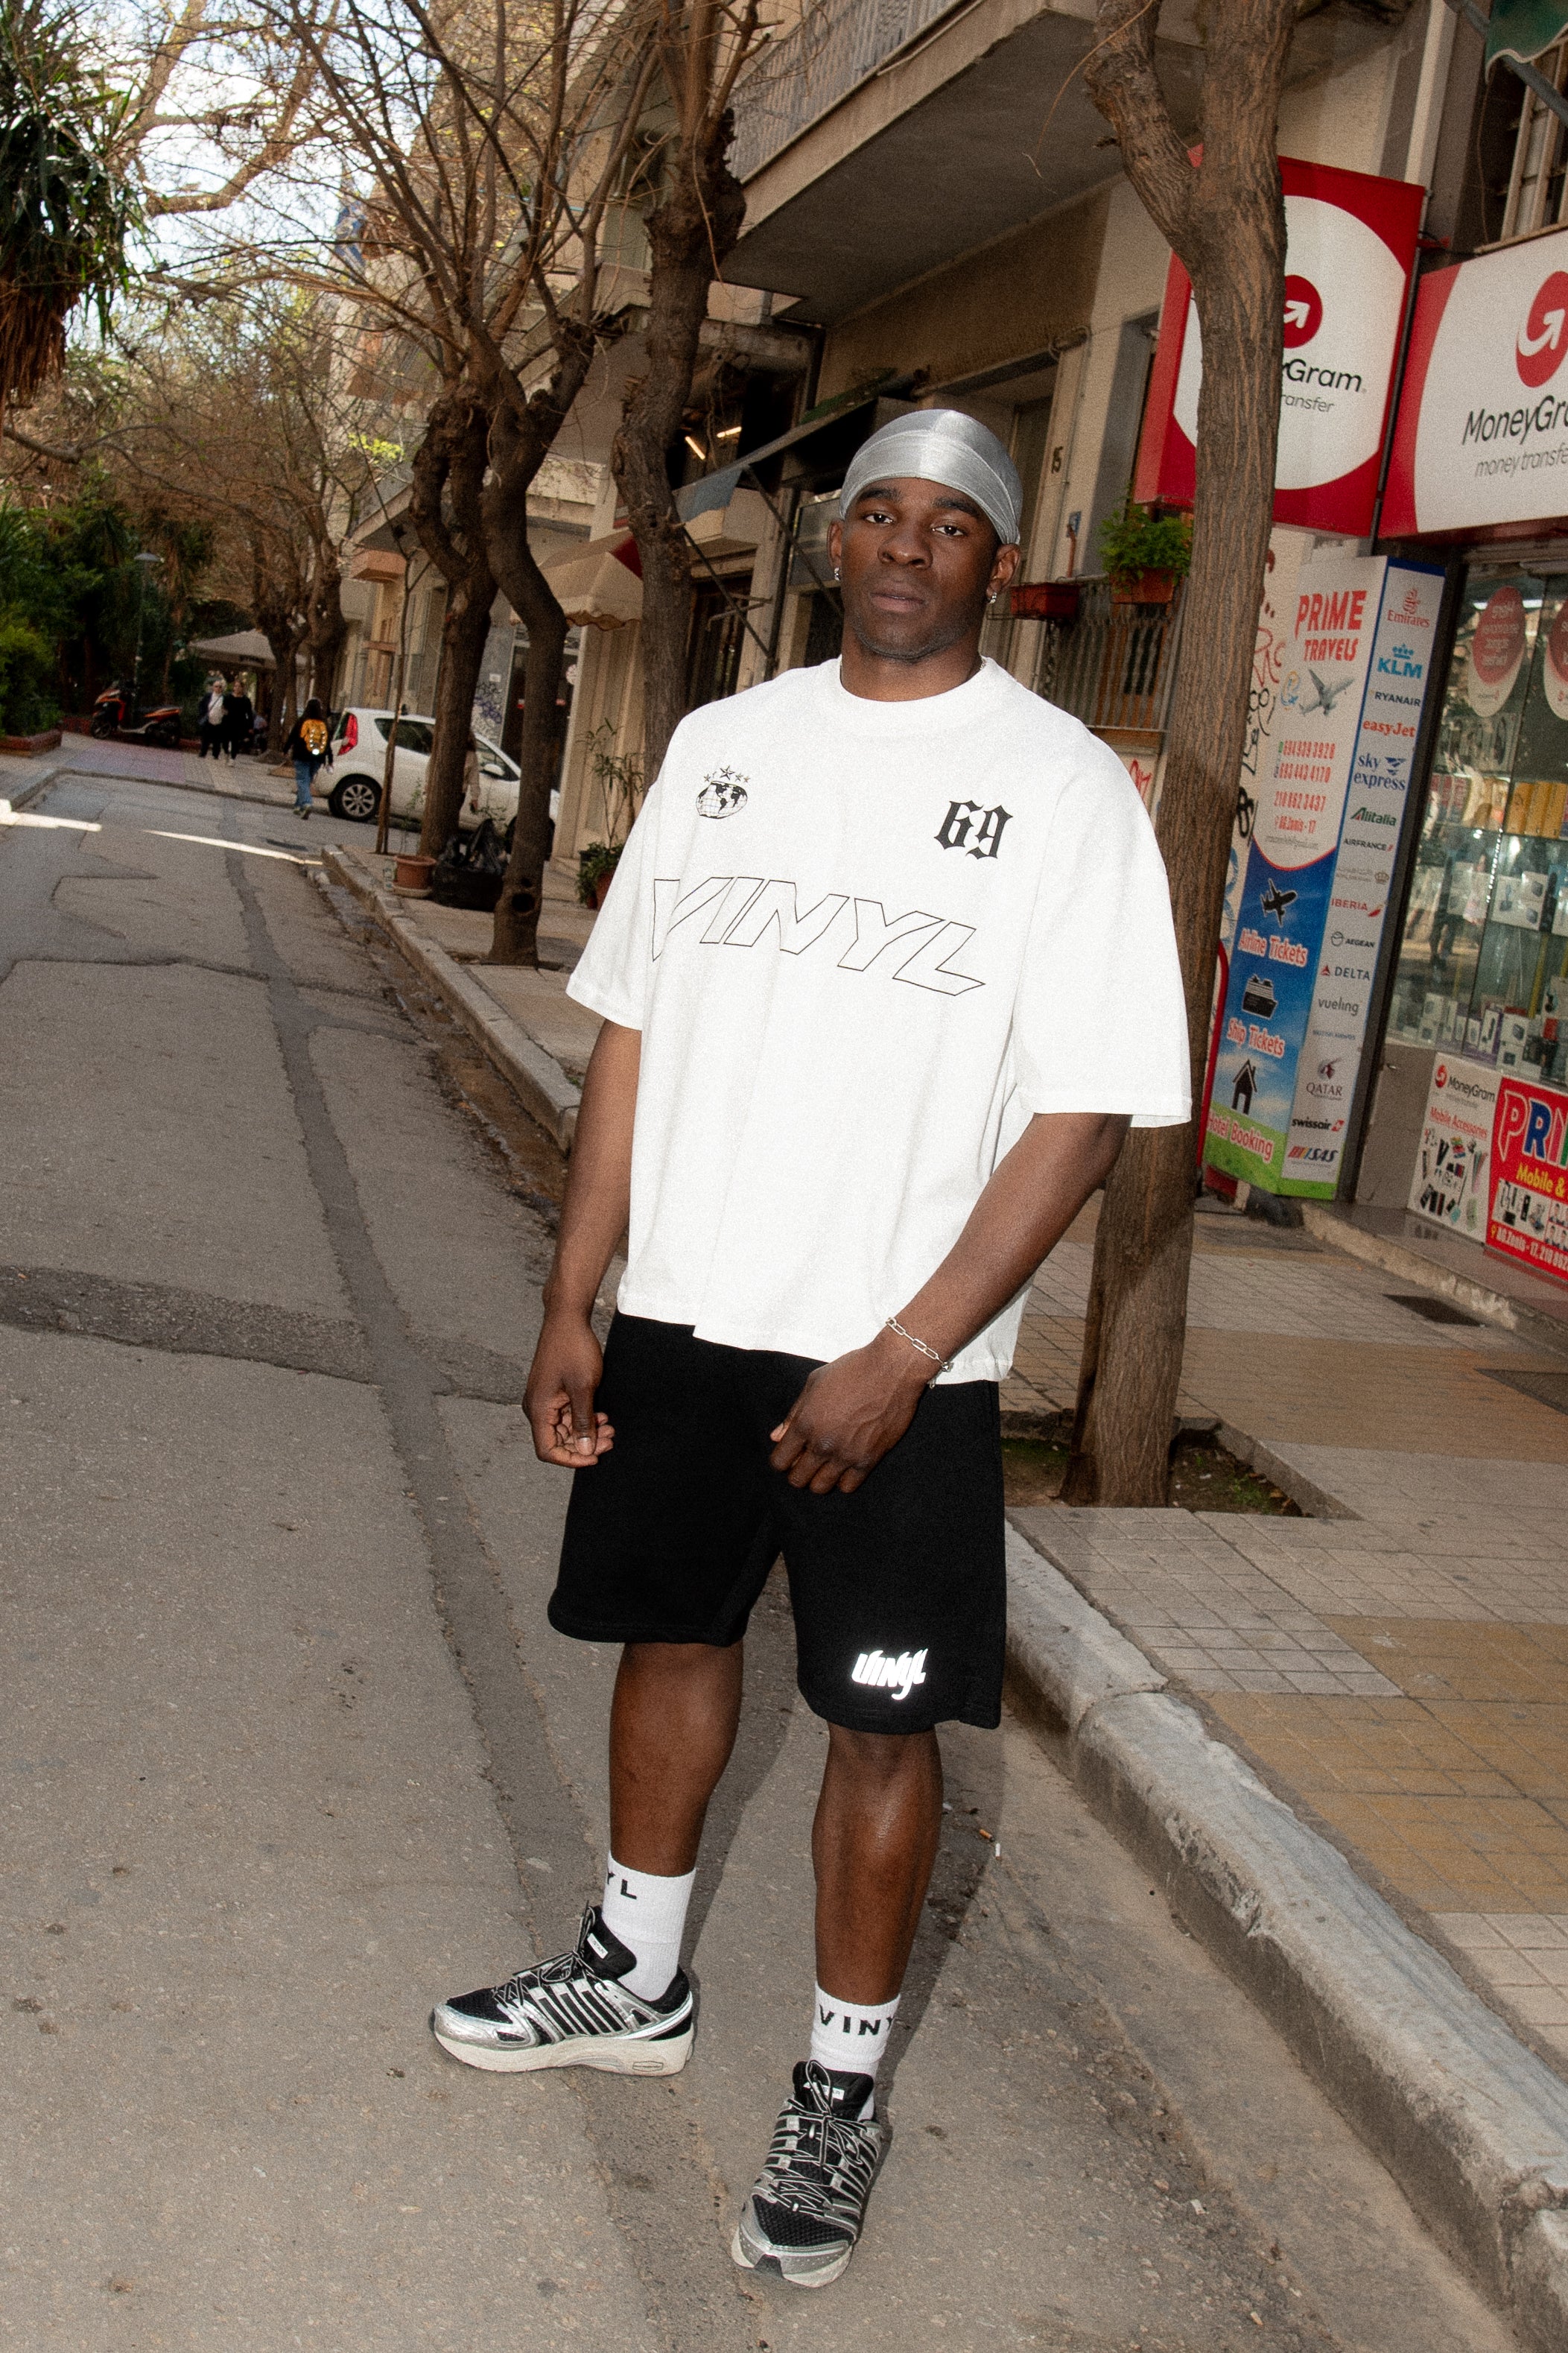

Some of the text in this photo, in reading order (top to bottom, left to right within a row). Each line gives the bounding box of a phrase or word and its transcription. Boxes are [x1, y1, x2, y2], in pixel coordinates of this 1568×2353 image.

[1282, 358, 1362, 392] Gram
[1475, 442, 1568, 478] money transfe
[1295, 590, 1367, 640] PRIME
[1387, 609, 1431, 628] Emirates
[1304, 638, 1359, 662] TRAVELS
[1378, 657, 1423, 679] KLM
[1374, 691, 1421, 707] RYANAIR
[1362, 720, 1416, 738] easyJet
[1358, 753, 1381, 769] sky
[1353, 771, 1406, 791] express
[1350, 807, 1397, 827] Alitalia
[933, 799, 1013, 860] 69
[1331, 898, 1368, 911] IBERIA
[653, 876, 985, 996] VINYL
[1345, 937, 1375, 949] AEGEAN
[1240, 928, 1308, 967] Airline Tickets
[1334, 966, 1371, 981] DELTA
[1318, 996, 1359, 1016] vueling
[1226, 1016, 1286, 1059] Ship Tickets
[1306, 1082, 1342, 1097] QATAR
[1448, 1076, 1495, 1103] MoneyGram
[1291, 1117, 1331, 1130] swissair
[1429, 1106, 1452, 1125] Mobile
[1207, 1110, 1275, 1165] Hotel Booking
[1499, 1090, 1568, 1170] PRI
[1308, 1147, 1339, 1162] SAS
[1516, 1162, 1565, 1198] Mobile &
